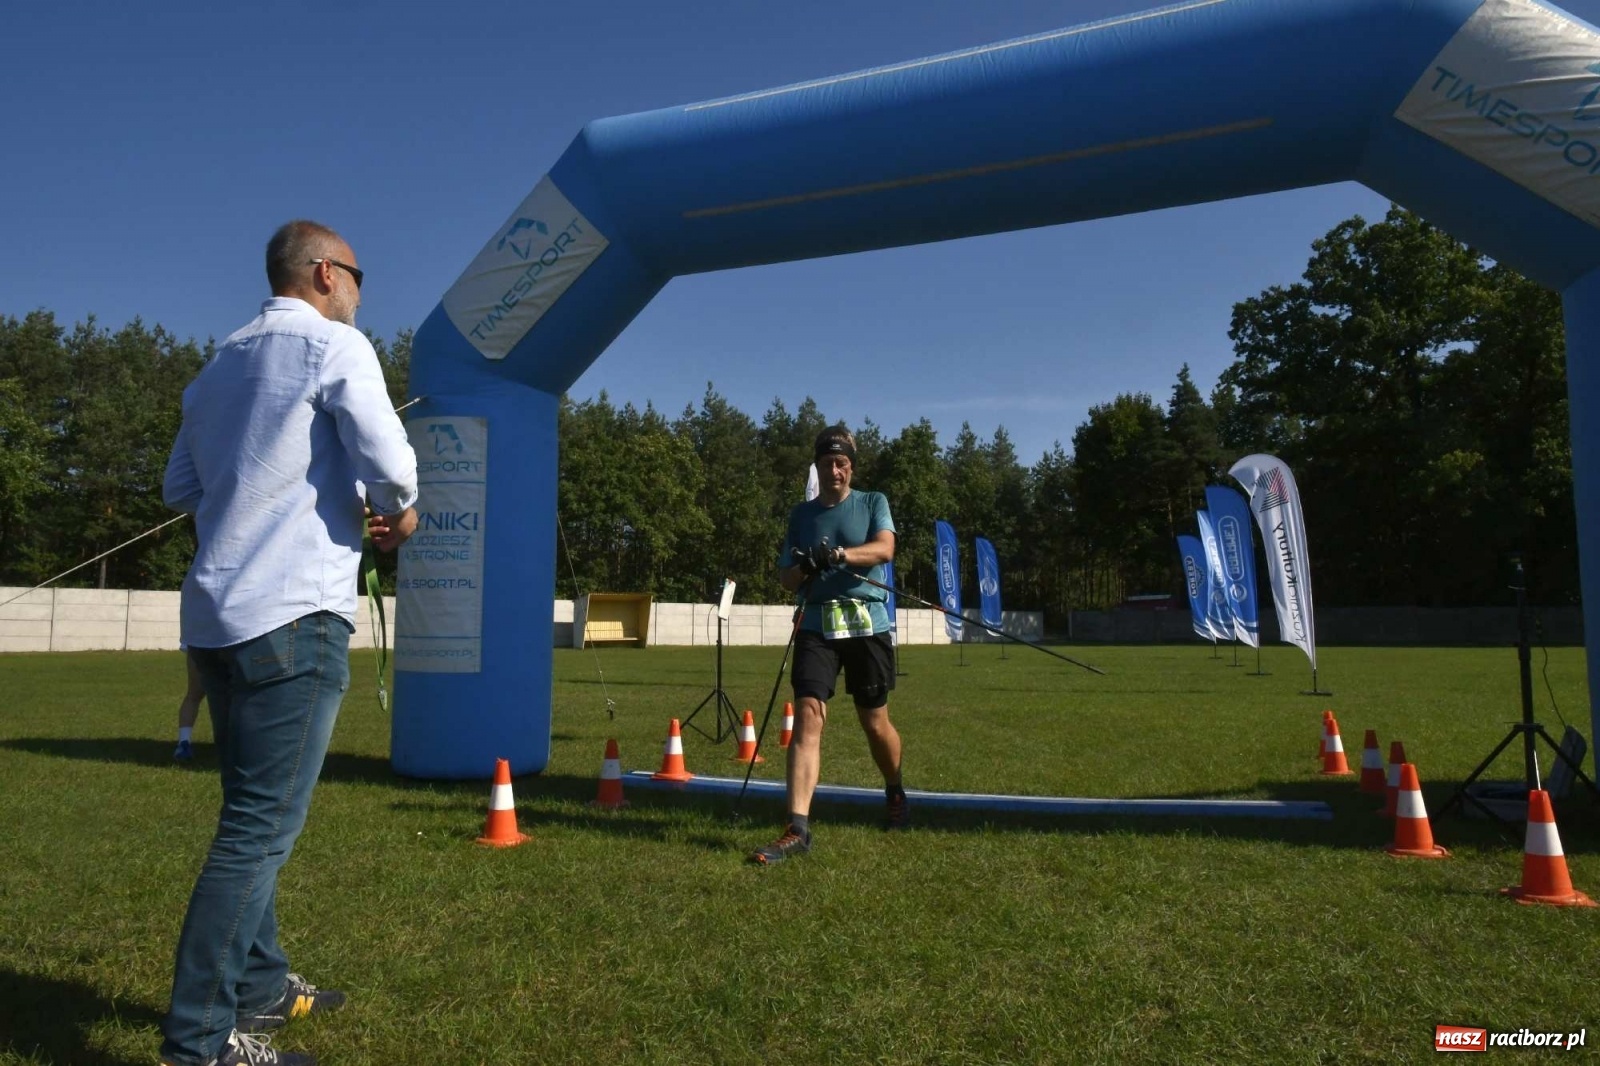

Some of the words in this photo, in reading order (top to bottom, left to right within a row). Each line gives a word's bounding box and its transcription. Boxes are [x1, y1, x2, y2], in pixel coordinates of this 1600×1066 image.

[1430, 66, 1600, 175] TIMESPO
[469, 217, 583, 340] TIMESPORT
[417, 461, 482, 472] SPORT
[417, 512, 479, 531] YNIKI
